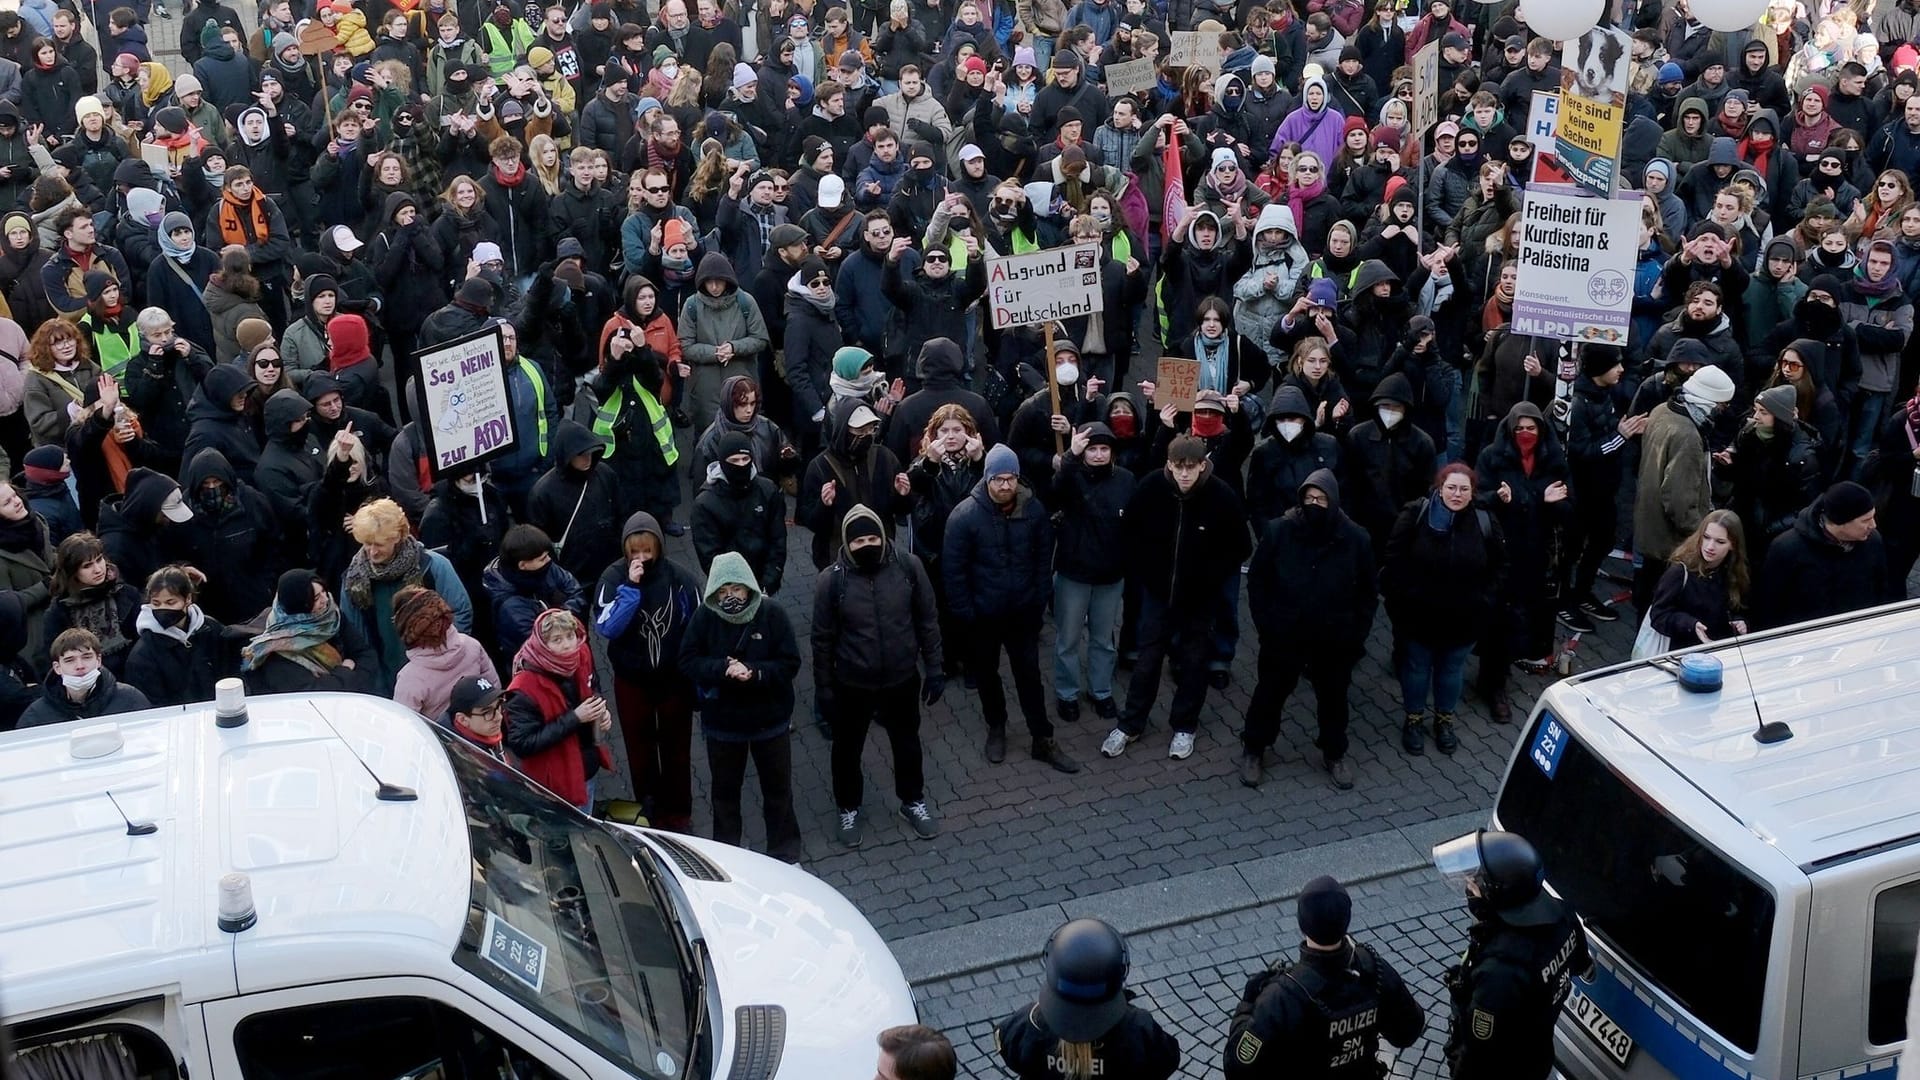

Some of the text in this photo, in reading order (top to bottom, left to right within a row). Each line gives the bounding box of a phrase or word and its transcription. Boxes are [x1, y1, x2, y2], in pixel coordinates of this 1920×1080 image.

[1562, 91, 1611, 121] Tiere sind
[1569, 111, 1595, 132] keine
[1564, 124, 1602, 151] Sachen!
[1527, 201, 1607, 227] Freiheit für
[1525, 224, 1609, 250] Kurdistan &
[992, 252, 1066, 283] Abgrund
[1523, 247, 1590, 272] Palästina
[995, 286, 1022, 304] für
[1520, 289, 1570, 303] Konsequent.
[996, 293, 1092, 327] Deutschland
[1518, 305, 1626, 323] Internationalistische Liste
[1516, 317, 1570, 336] MLPD
[429, 369, 455, 386] Sag
[460, 350, 495, 378] NEIN!
[1170, 374, 1194, 386] die
[441, 415, 509, 467] zur AfD!
[1548, 721, 1561, 741] SN
[1540, 735, 1556, 756] 221
[495, 930, 507, 951] SN
[510, 940, 523, 964] 222
[525, 945, 539, 976] BeSi
[1329, 1008, 1378, 1039] POLIZEI
[1577, 996, 1629, 1058] Q 7448
[1342, 1036, 1362, 1051] SN
[1330, 1045, 1364, 1067] 22/11
